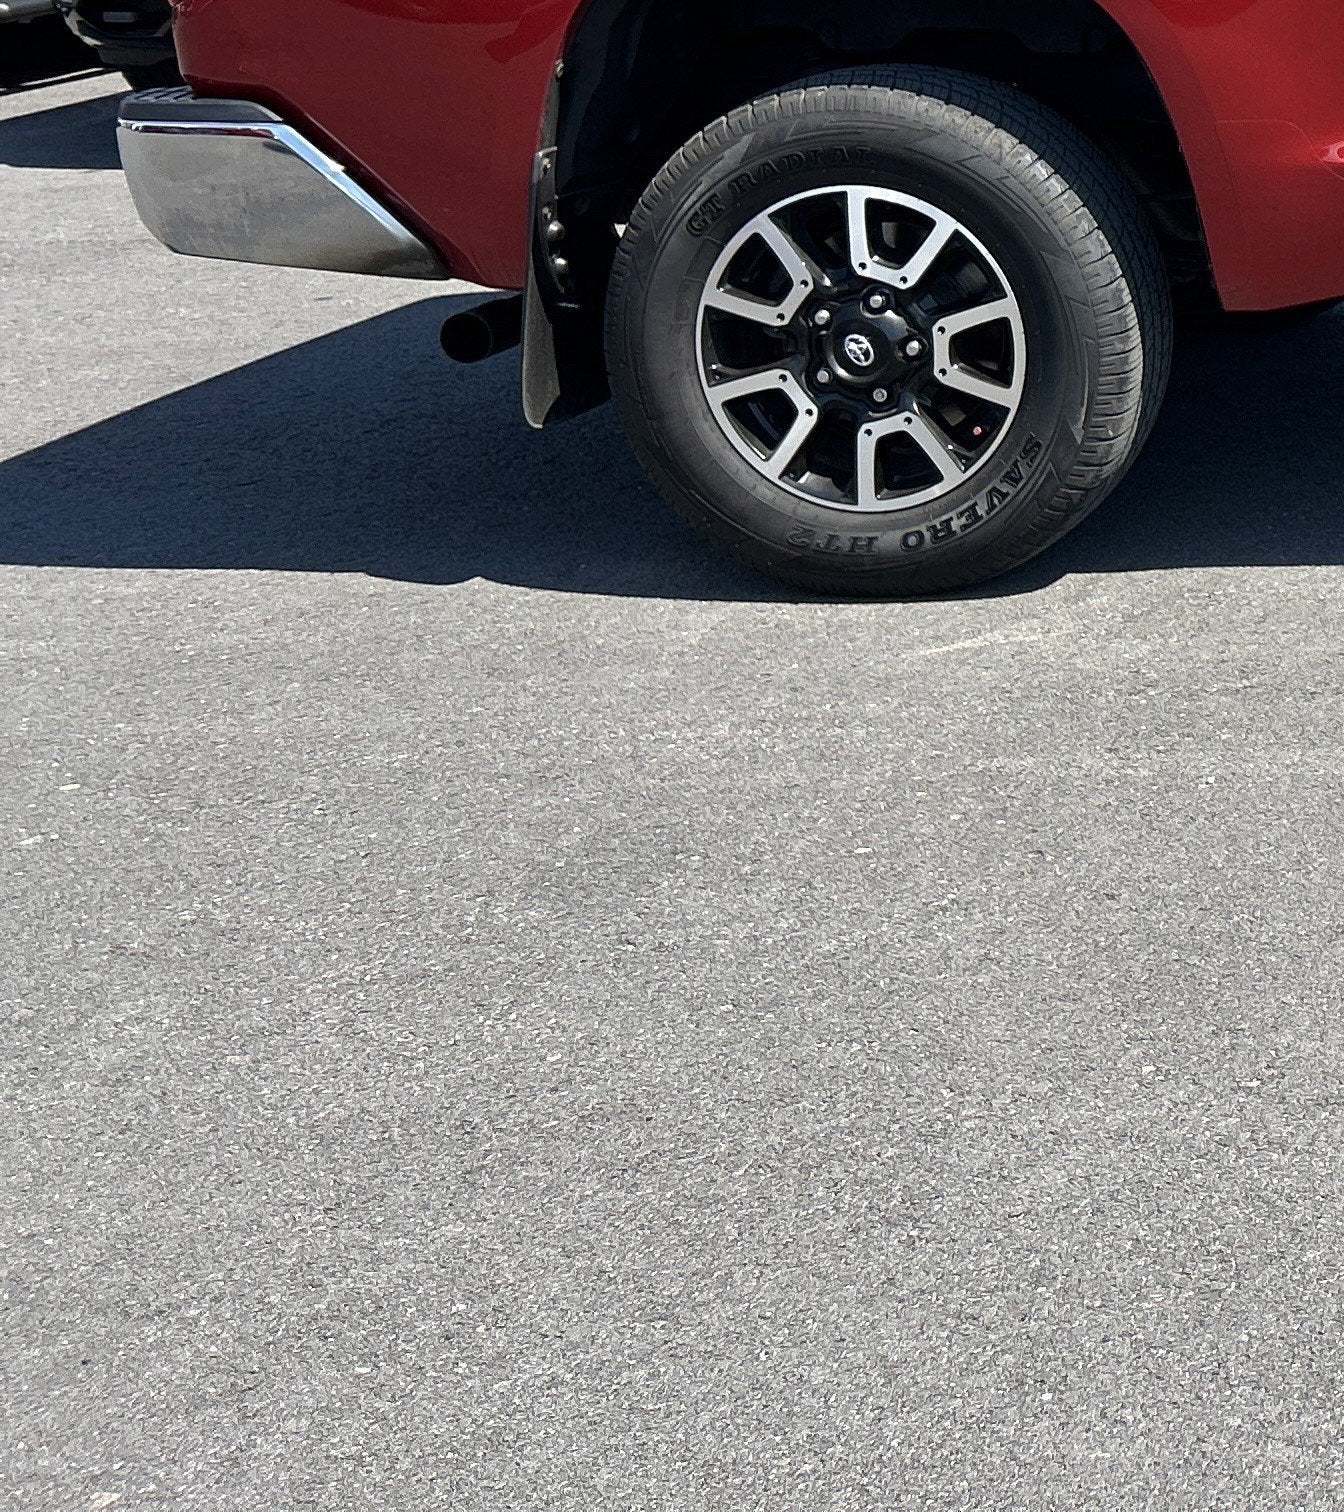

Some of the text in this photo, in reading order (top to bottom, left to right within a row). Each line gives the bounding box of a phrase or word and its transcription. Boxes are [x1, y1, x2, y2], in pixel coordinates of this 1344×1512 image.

[686, 144, 876, 238] GT RADIAL
[784, 432, 1043, 556] SAVERO HT2
